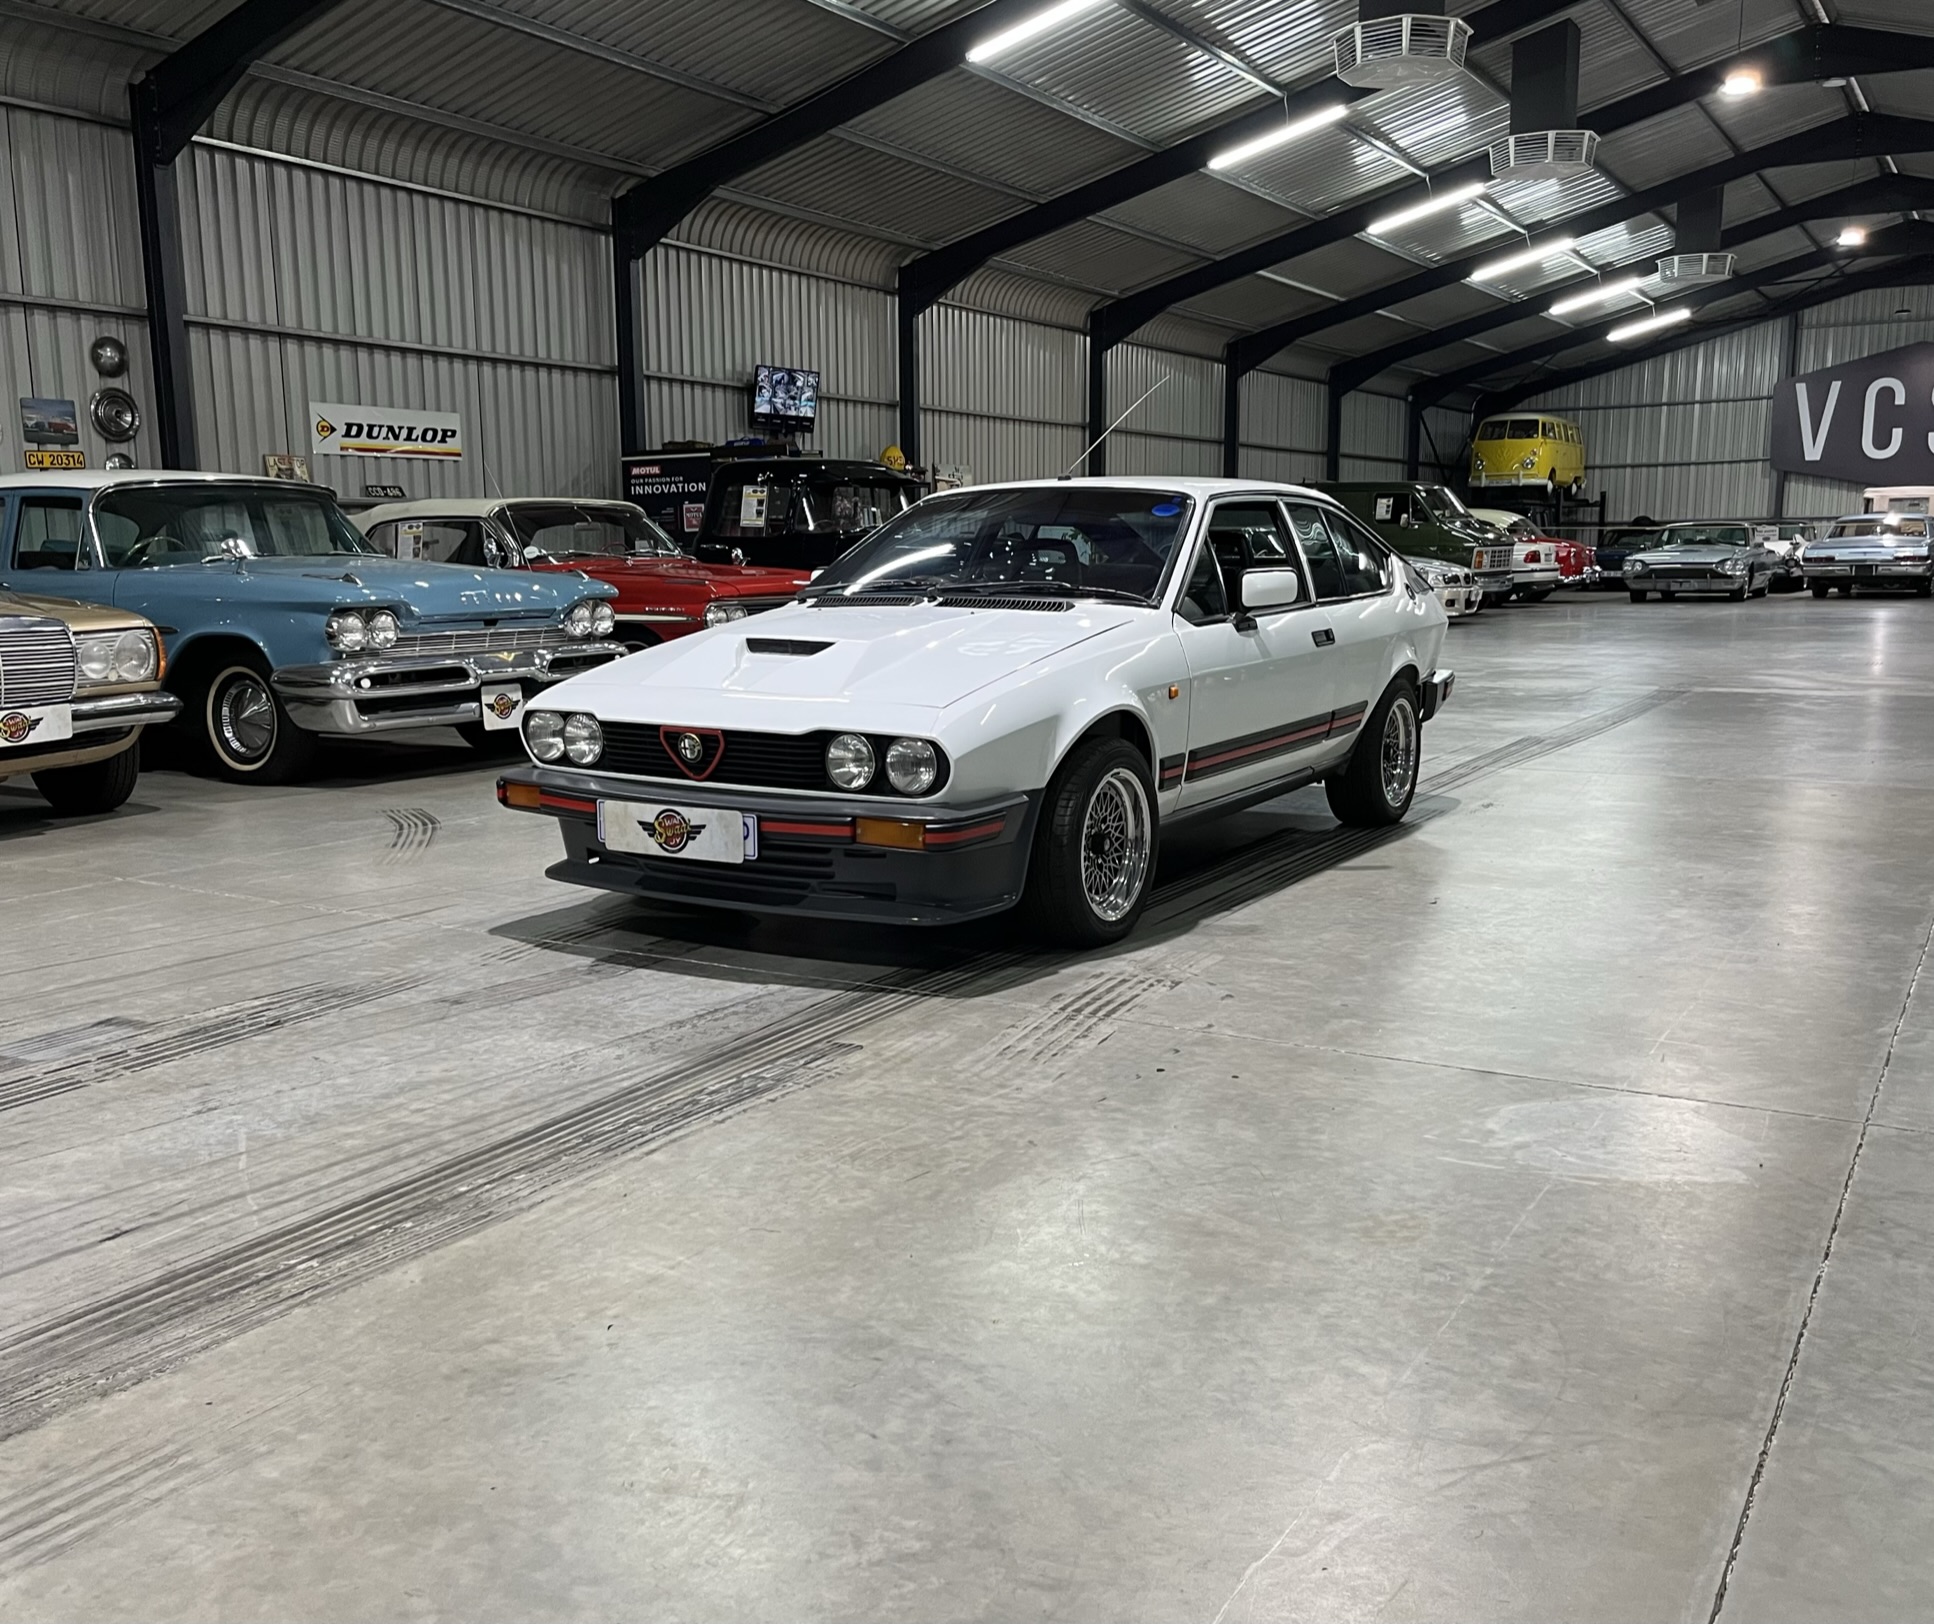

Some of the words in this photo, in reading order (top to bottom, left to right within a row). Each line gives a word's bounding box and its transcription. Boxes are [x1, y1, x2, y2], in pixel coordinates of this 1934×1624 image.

[1795, 377, 1934, 461] VC
[341, 422, 457, 444] DUNLOP
[28, 453, 44, 466] CW
[48, 453, 83, 466] 20314
[631, 466, 660, 475] MOTUL
[631, 482, 706, 495] INNOVATION
[670, 837, 681, 845] JY
